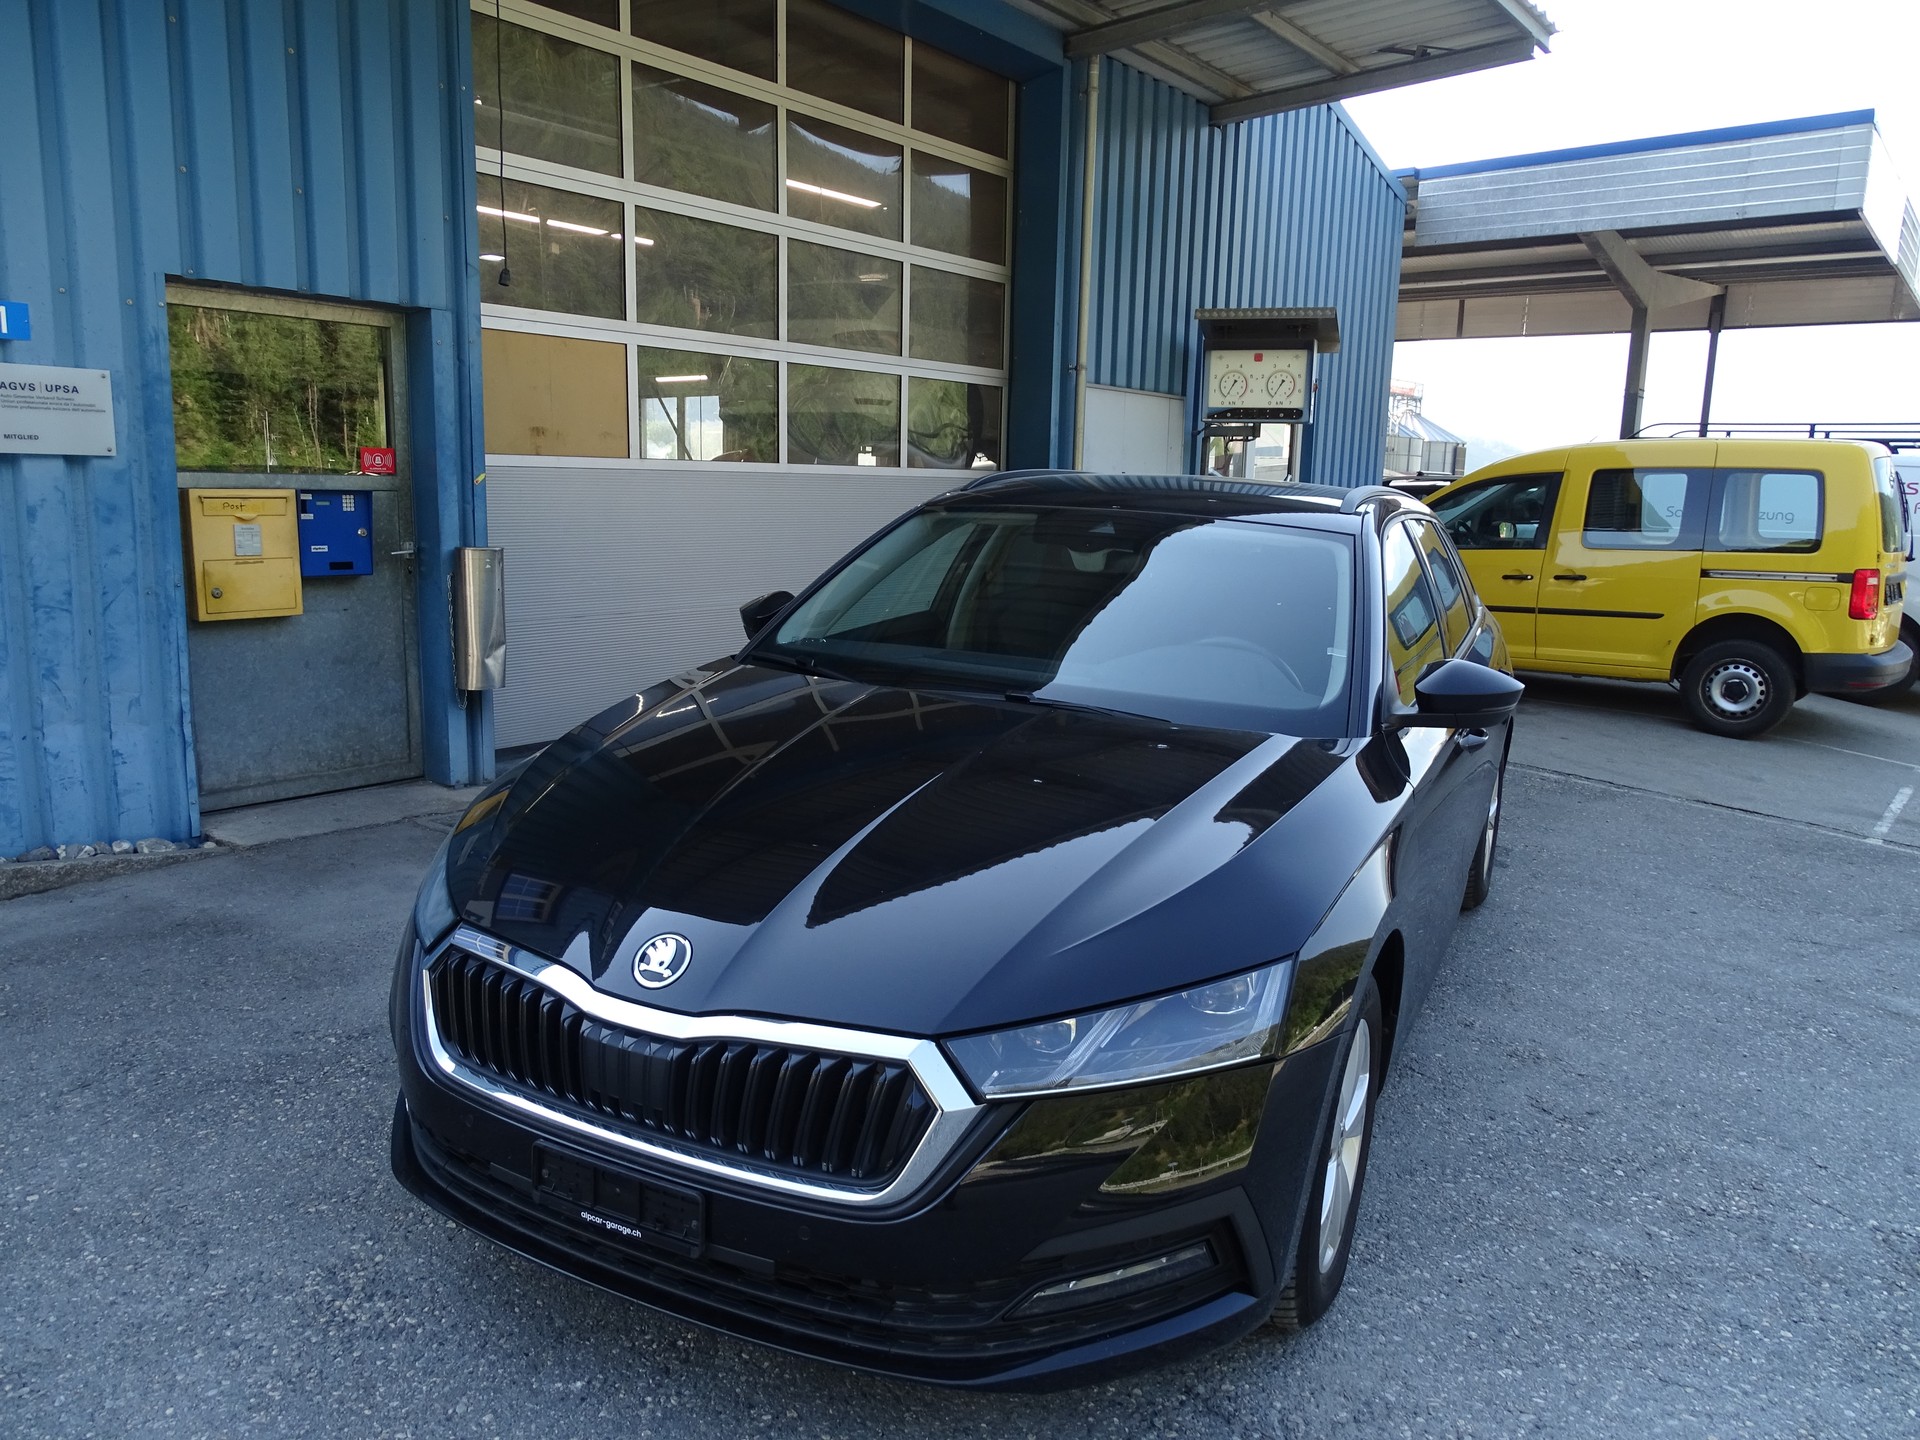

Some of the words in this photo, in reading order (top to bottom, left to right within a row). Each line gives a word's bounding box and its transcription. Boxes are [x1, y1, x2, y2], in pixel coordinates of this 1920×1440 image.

[0, 381, 36, 392] AGVS
[45, 383, 80, 394] UPSA
[222, 501, 246, 512] Post
[580, 1211, 642, 1238] alpcar-garage.ch
